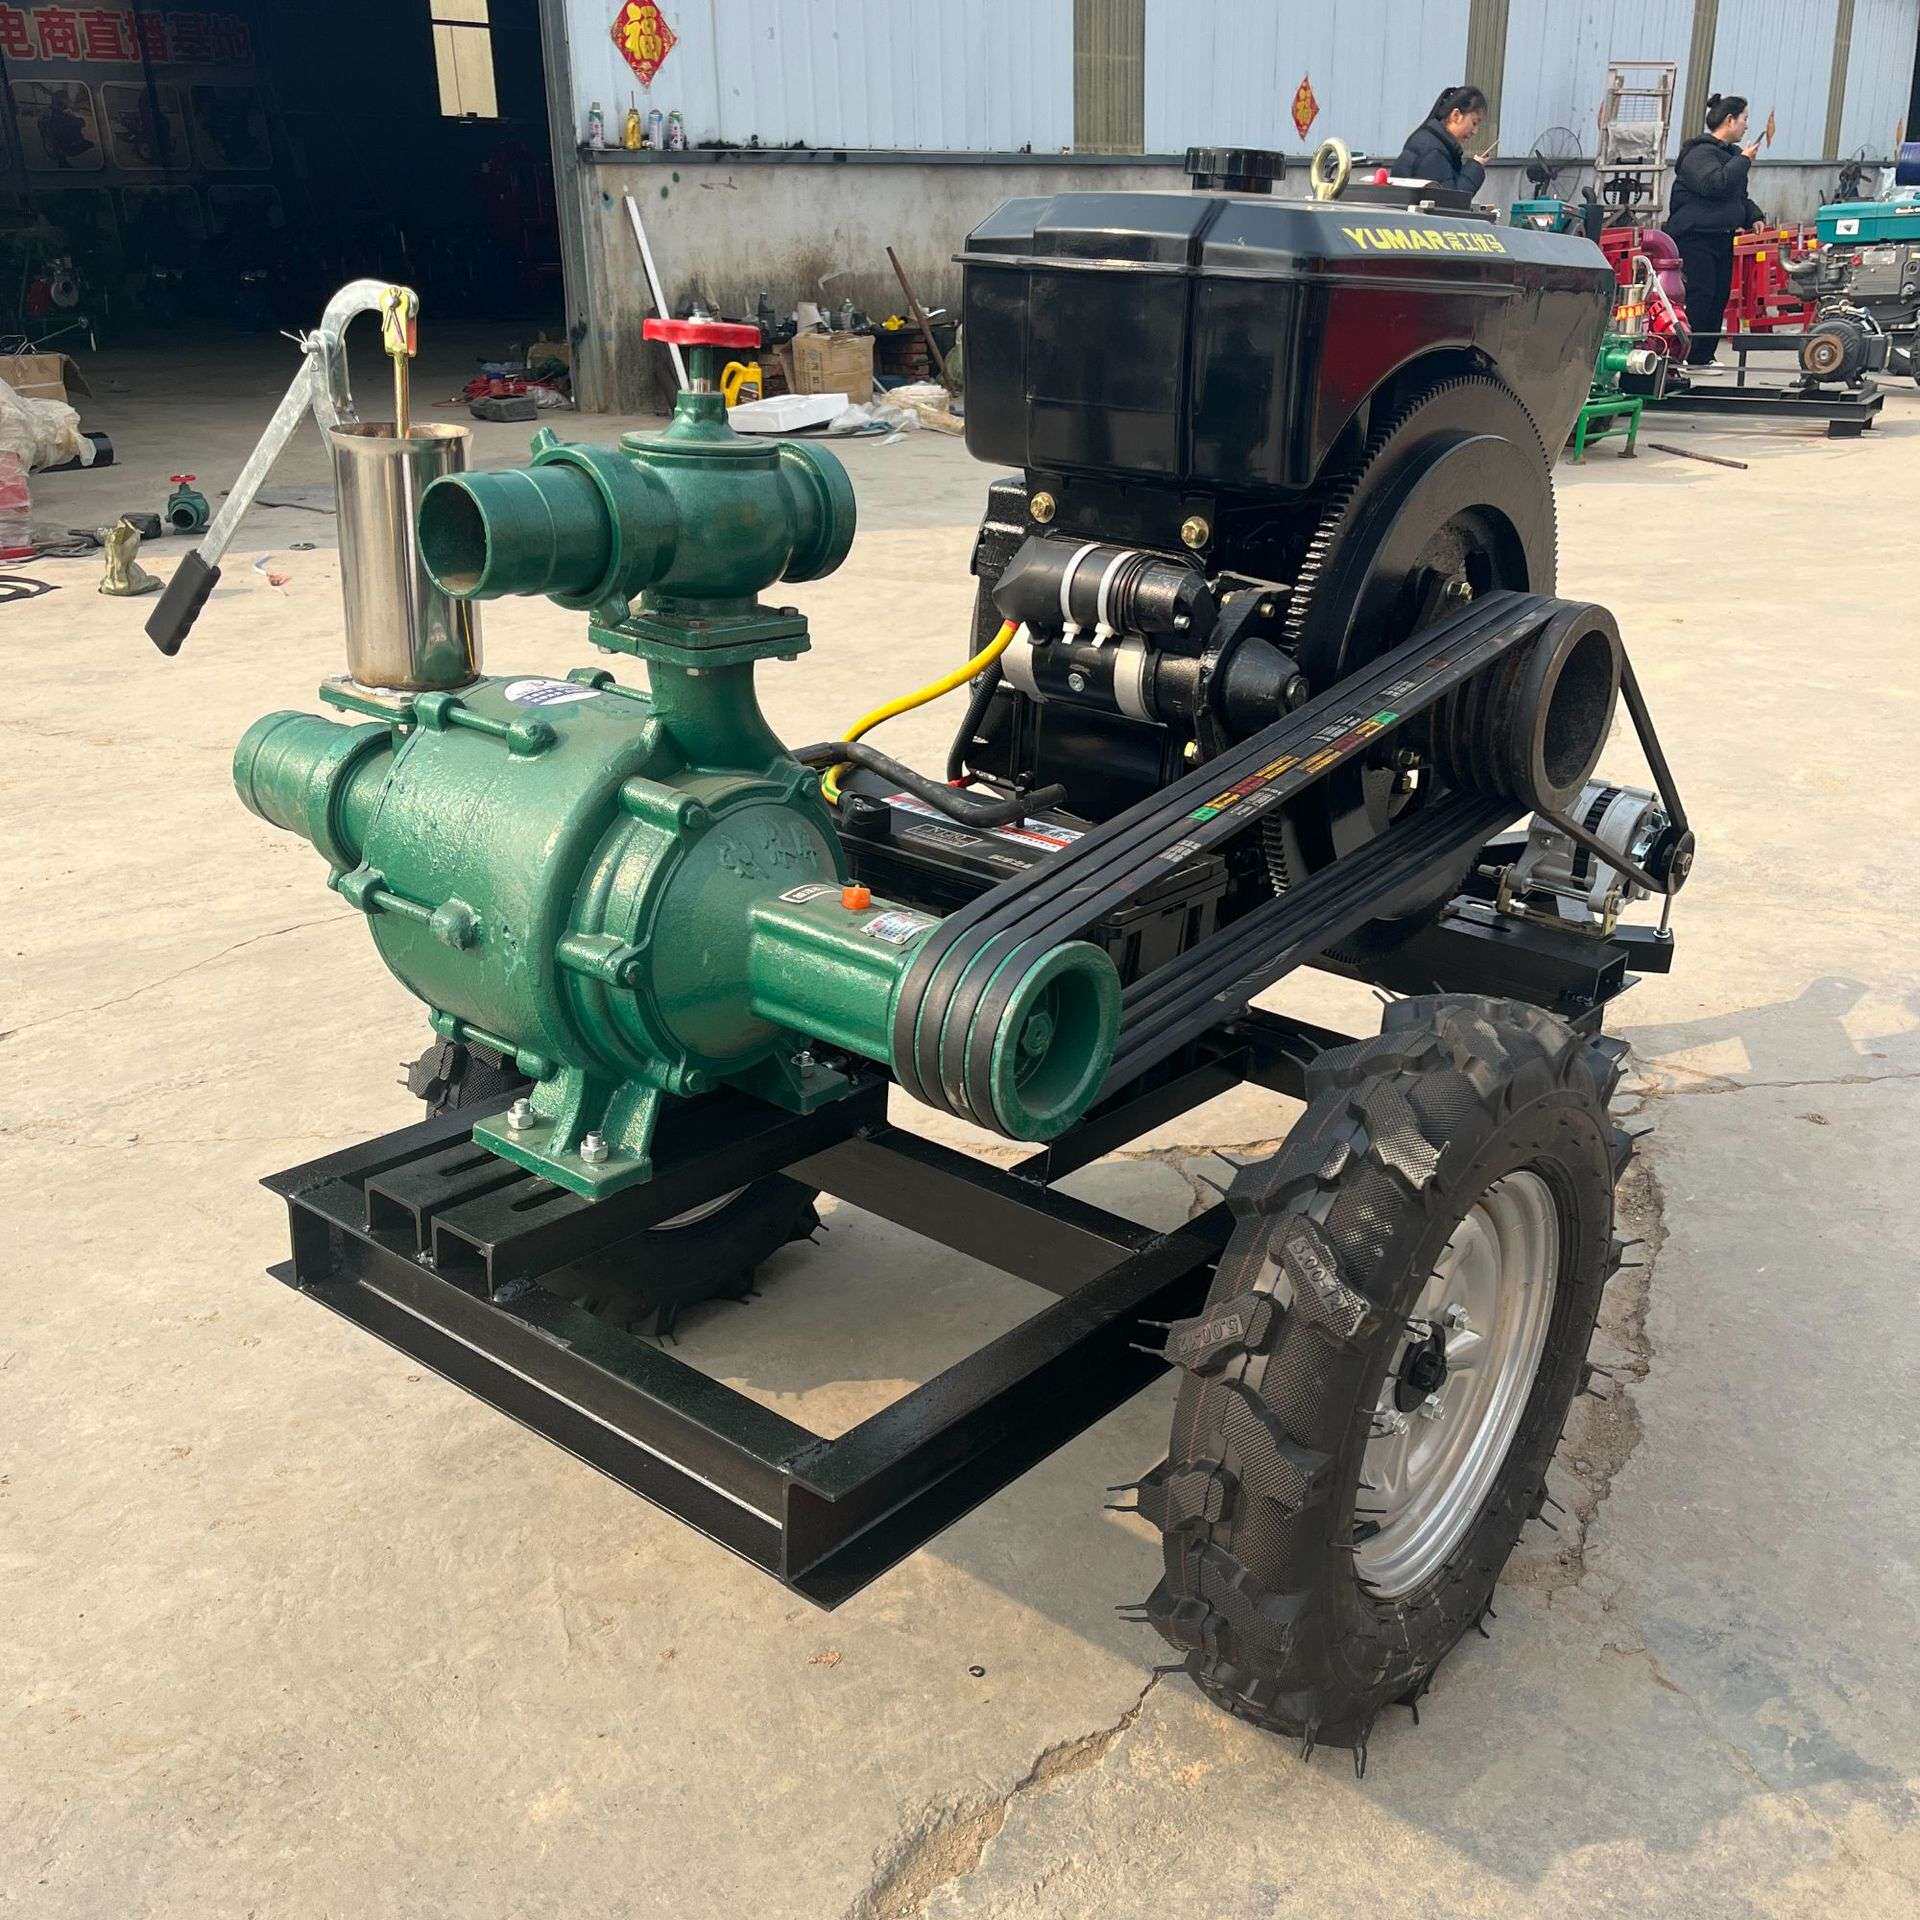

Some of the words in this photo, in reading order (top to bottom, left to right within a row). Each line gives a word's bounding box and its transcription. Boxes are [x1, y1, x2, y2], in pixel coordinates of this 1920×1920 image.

[622, 2, 663, 61] 福
[1341, 227, 1450, 251] YUMAR
[1290, 1241, 1347, 1312] 5.00-12
